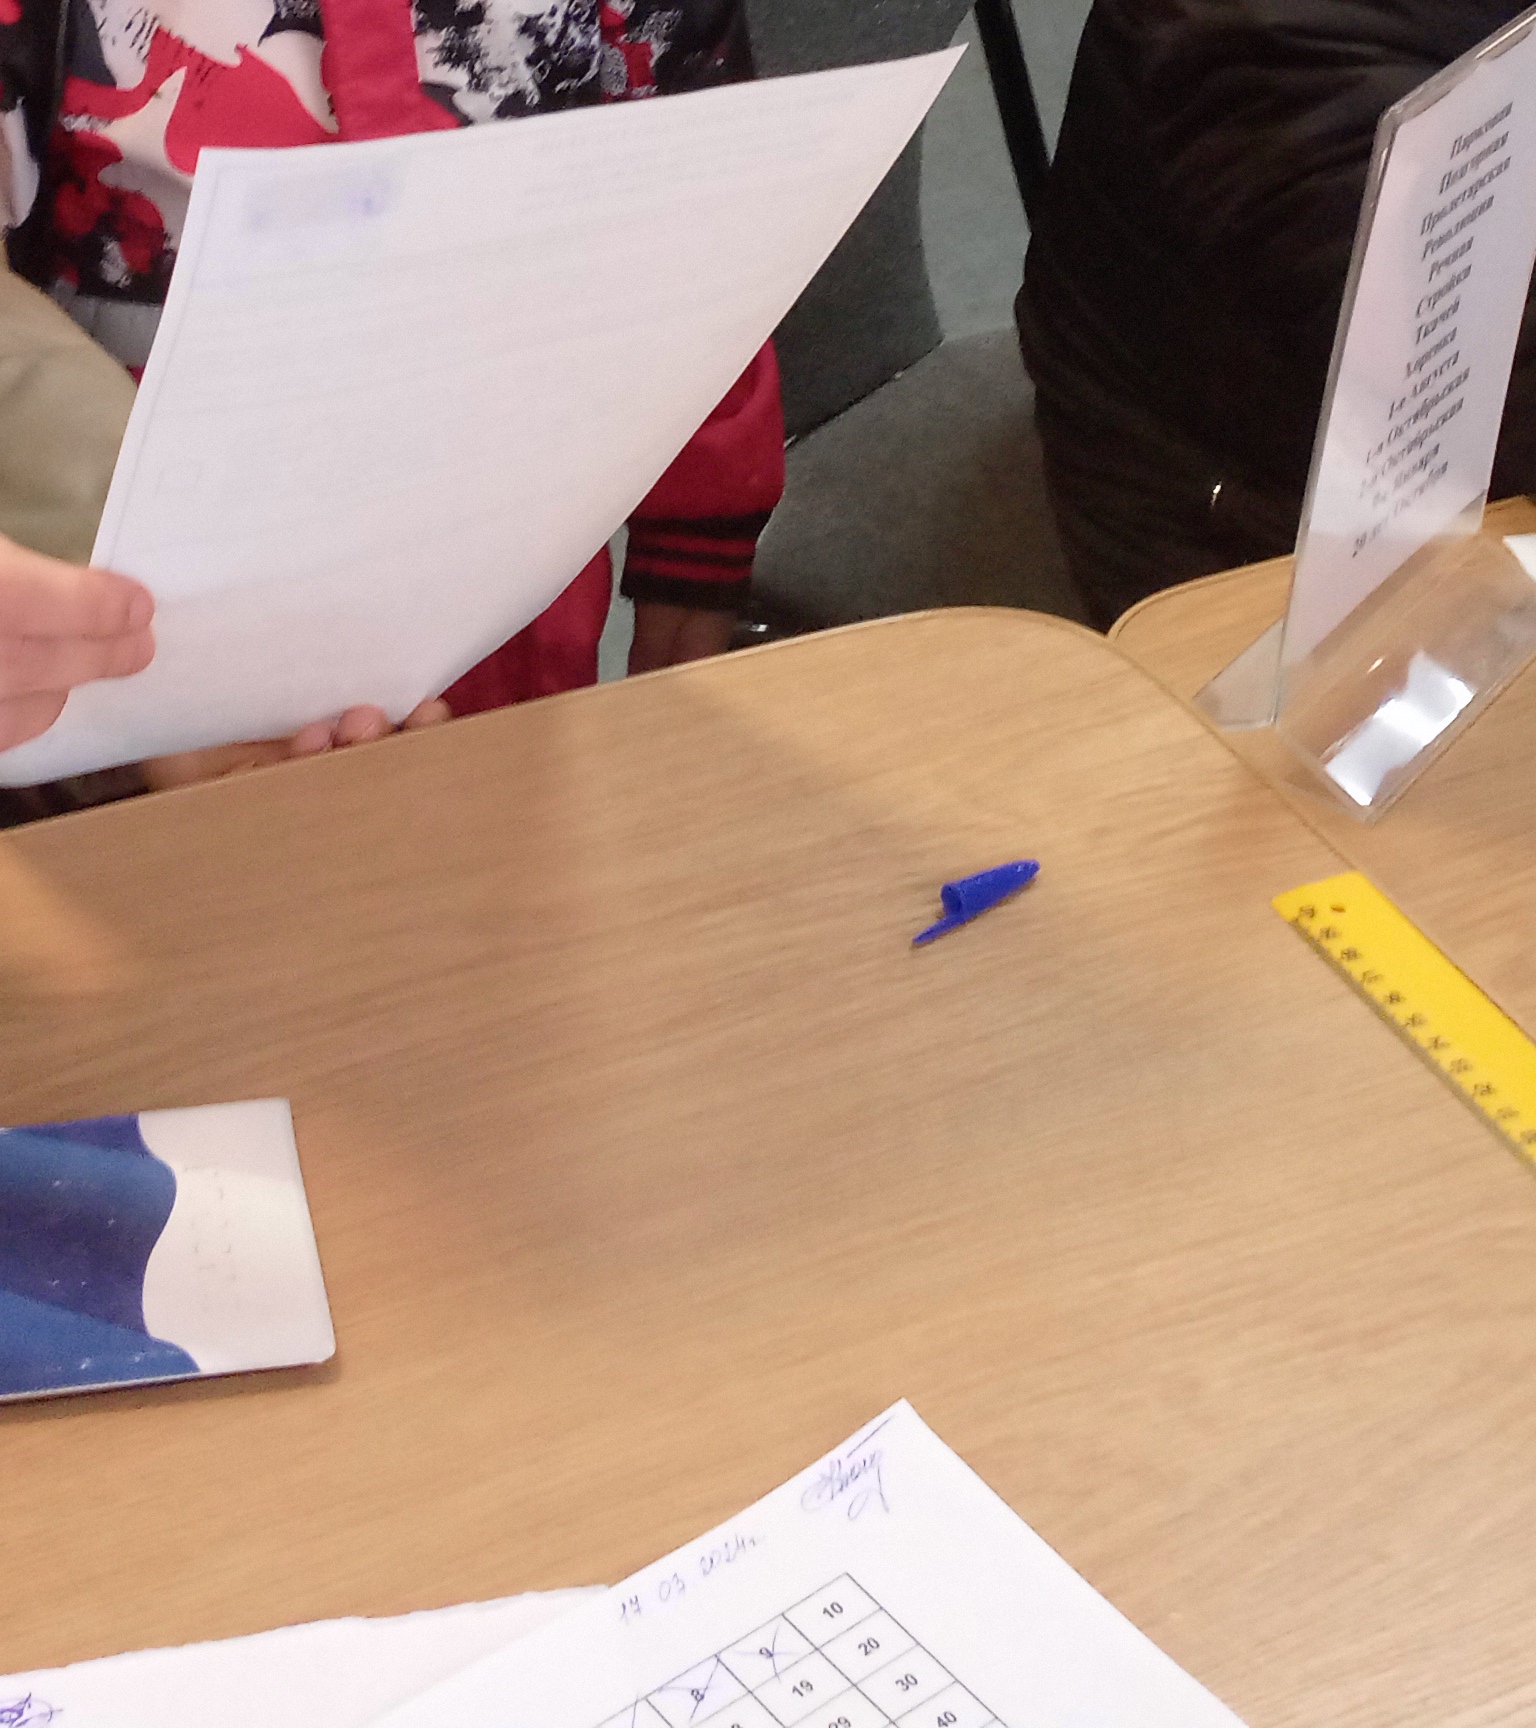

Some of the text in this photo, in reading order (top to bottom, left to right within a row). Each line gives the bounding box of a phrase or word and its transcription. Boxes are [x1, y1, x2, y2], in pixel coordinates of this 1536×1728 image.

[822, 1601, 845, 1620] 10
[791, 1636, 881, 1698] 19 20
[894, 1673, 919, 1693] 30
[935, 1710, 958, 1728] 40
